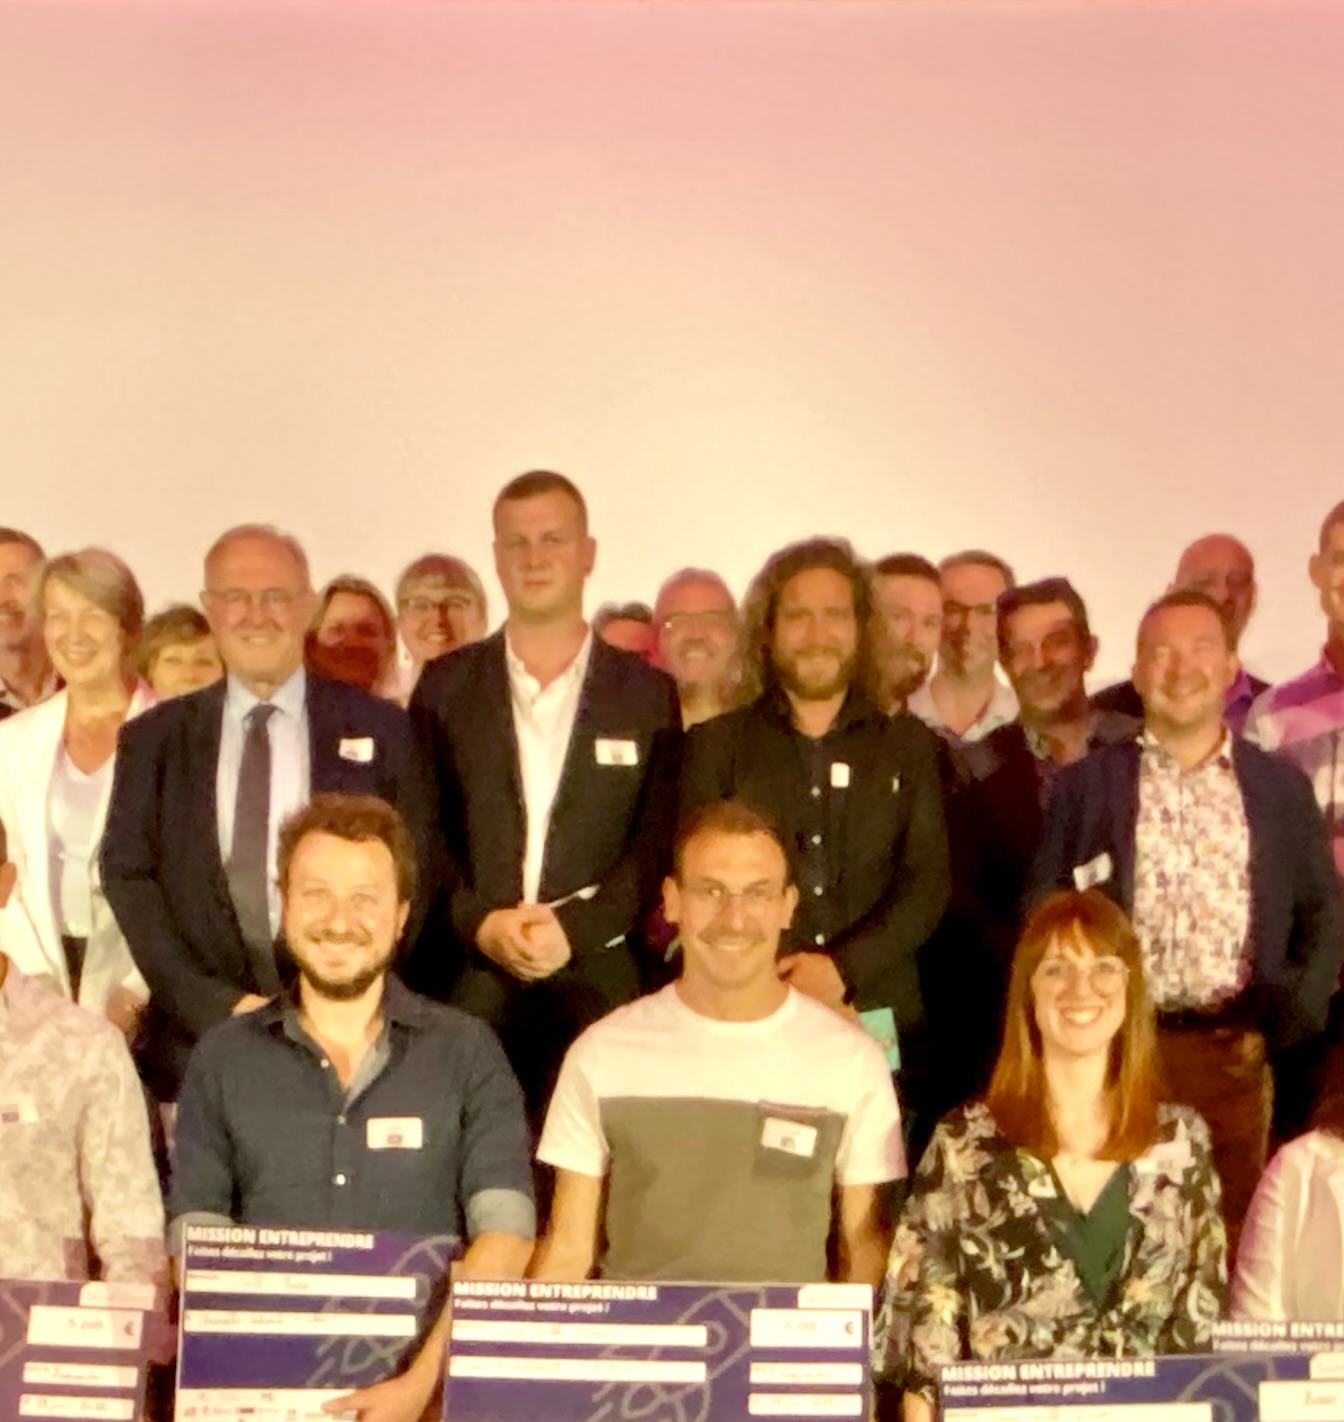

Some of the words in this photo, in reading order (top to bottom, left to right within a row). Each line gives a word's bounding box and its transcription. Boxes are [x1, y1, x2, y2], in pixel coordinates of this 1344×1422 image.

[187, 1225, 256, 1244] MISSION
[259, 1229, 374, 1249] ENTREPRENDRE
[295, 1249, 326, 1264] projet
[453, 1281, 525, 1298] MISSION
[530, 1283, 657, 1301] ENTREPRENDRE
[568, 1301, 603, 1315] projet
[1212, 1321, 1286, 1338] MISSION
[942, 1364, 1016, 1381] MISSION
[1020, 1360, 1156, 1380] ENTREPRENDRE
[1029, 1383, 1062, 1395] votre
[1062, 1381, 1099, 1396] projet
